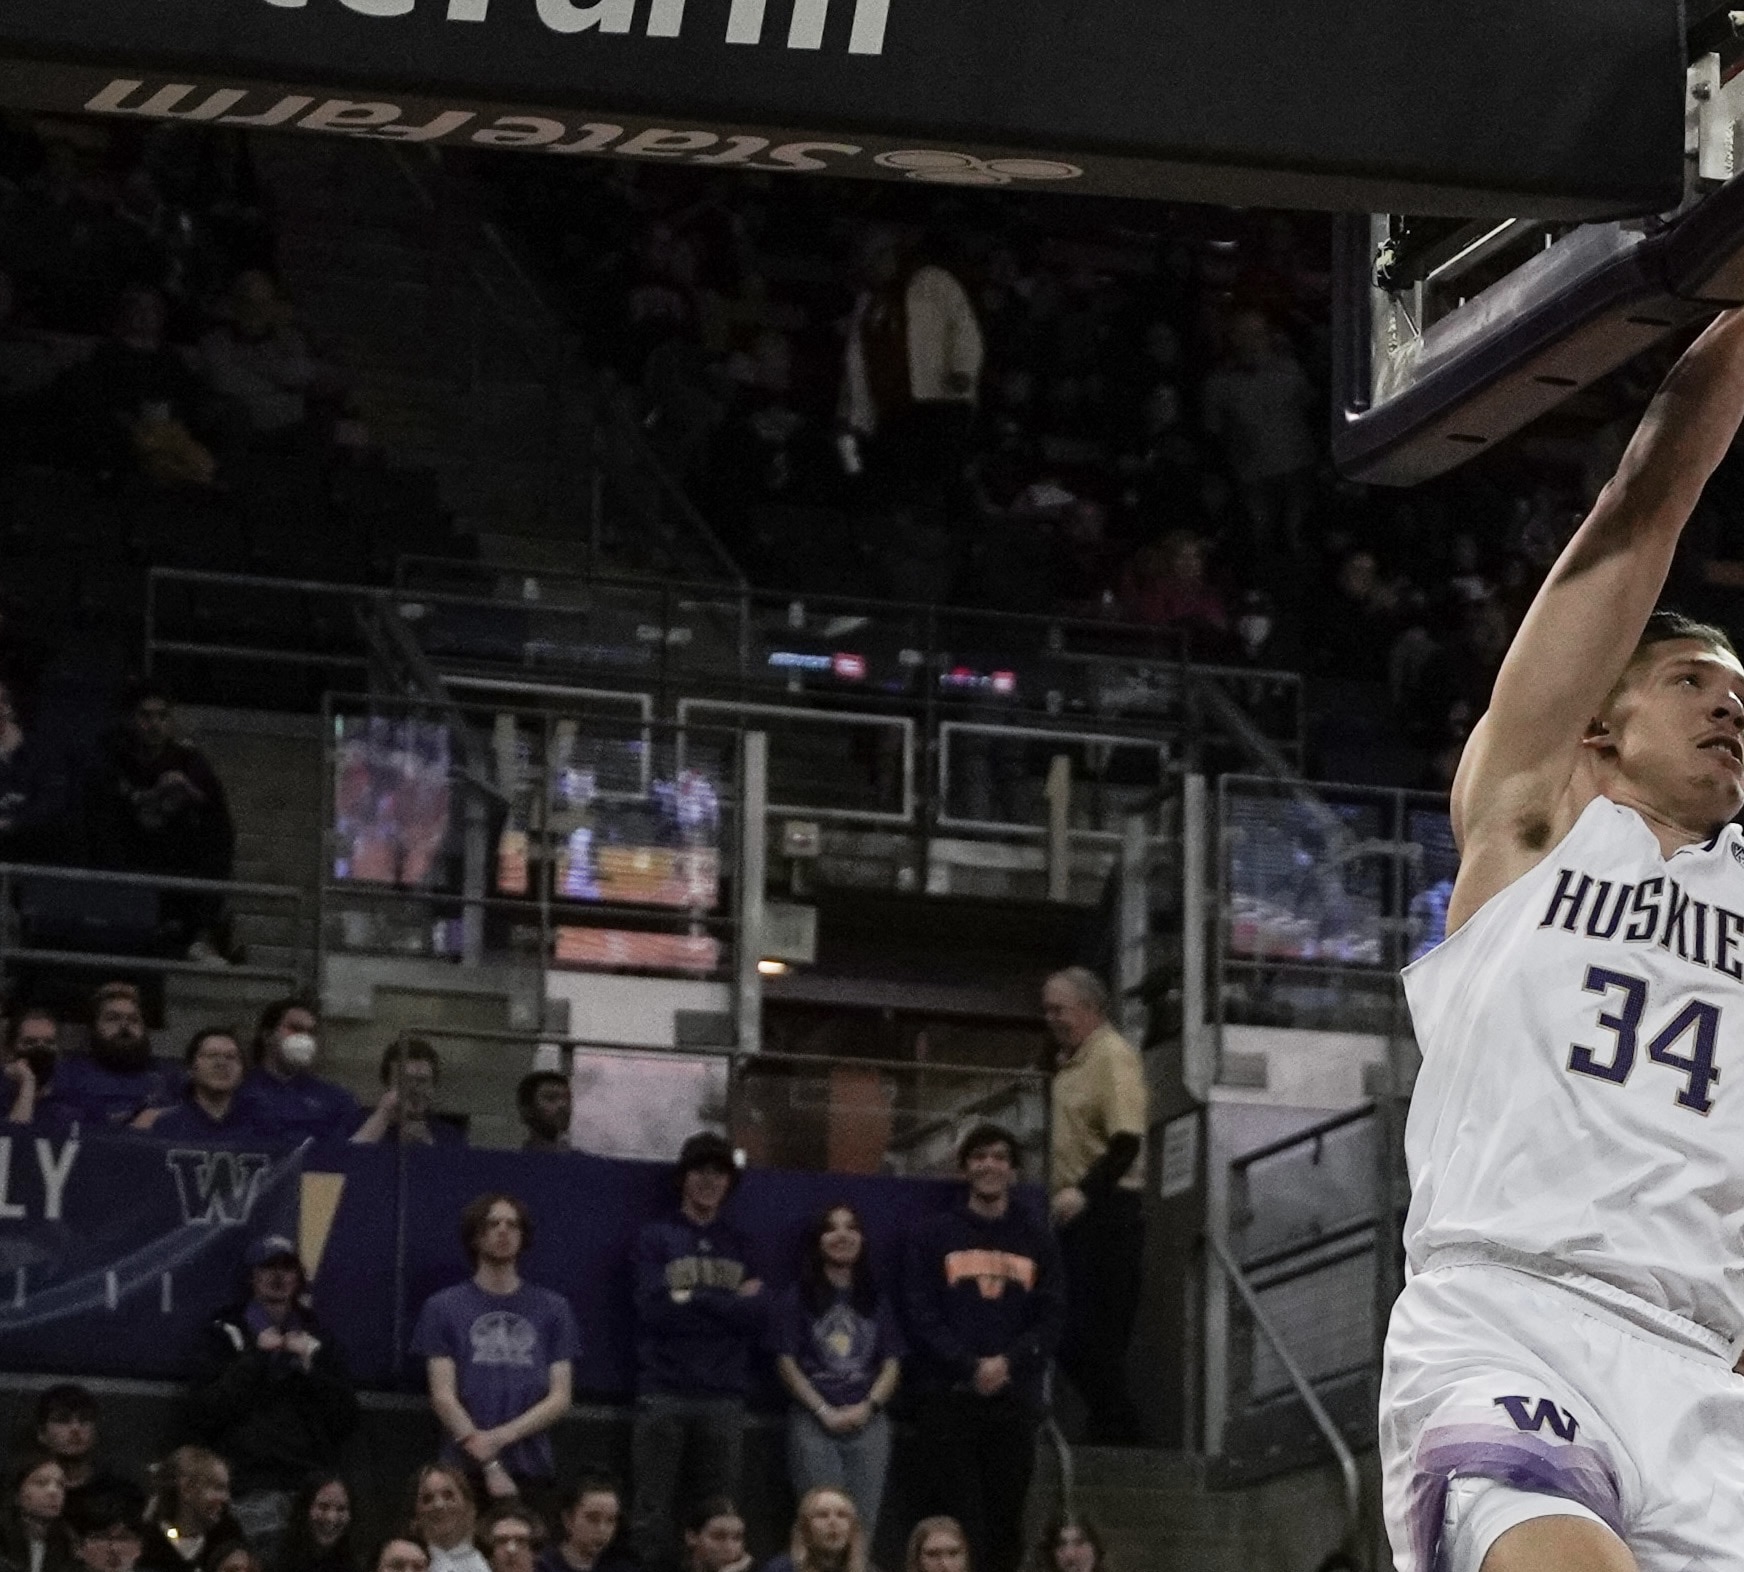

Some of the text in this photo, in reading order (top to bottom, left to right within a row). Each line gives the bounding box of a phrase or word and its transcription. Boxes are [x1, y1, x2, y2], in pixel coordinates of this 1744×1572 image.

[1566, 964, 1723, 1117] 34
[165, 1149, 272, 1226] W
[1494, 1395, 1580, 1443] W
